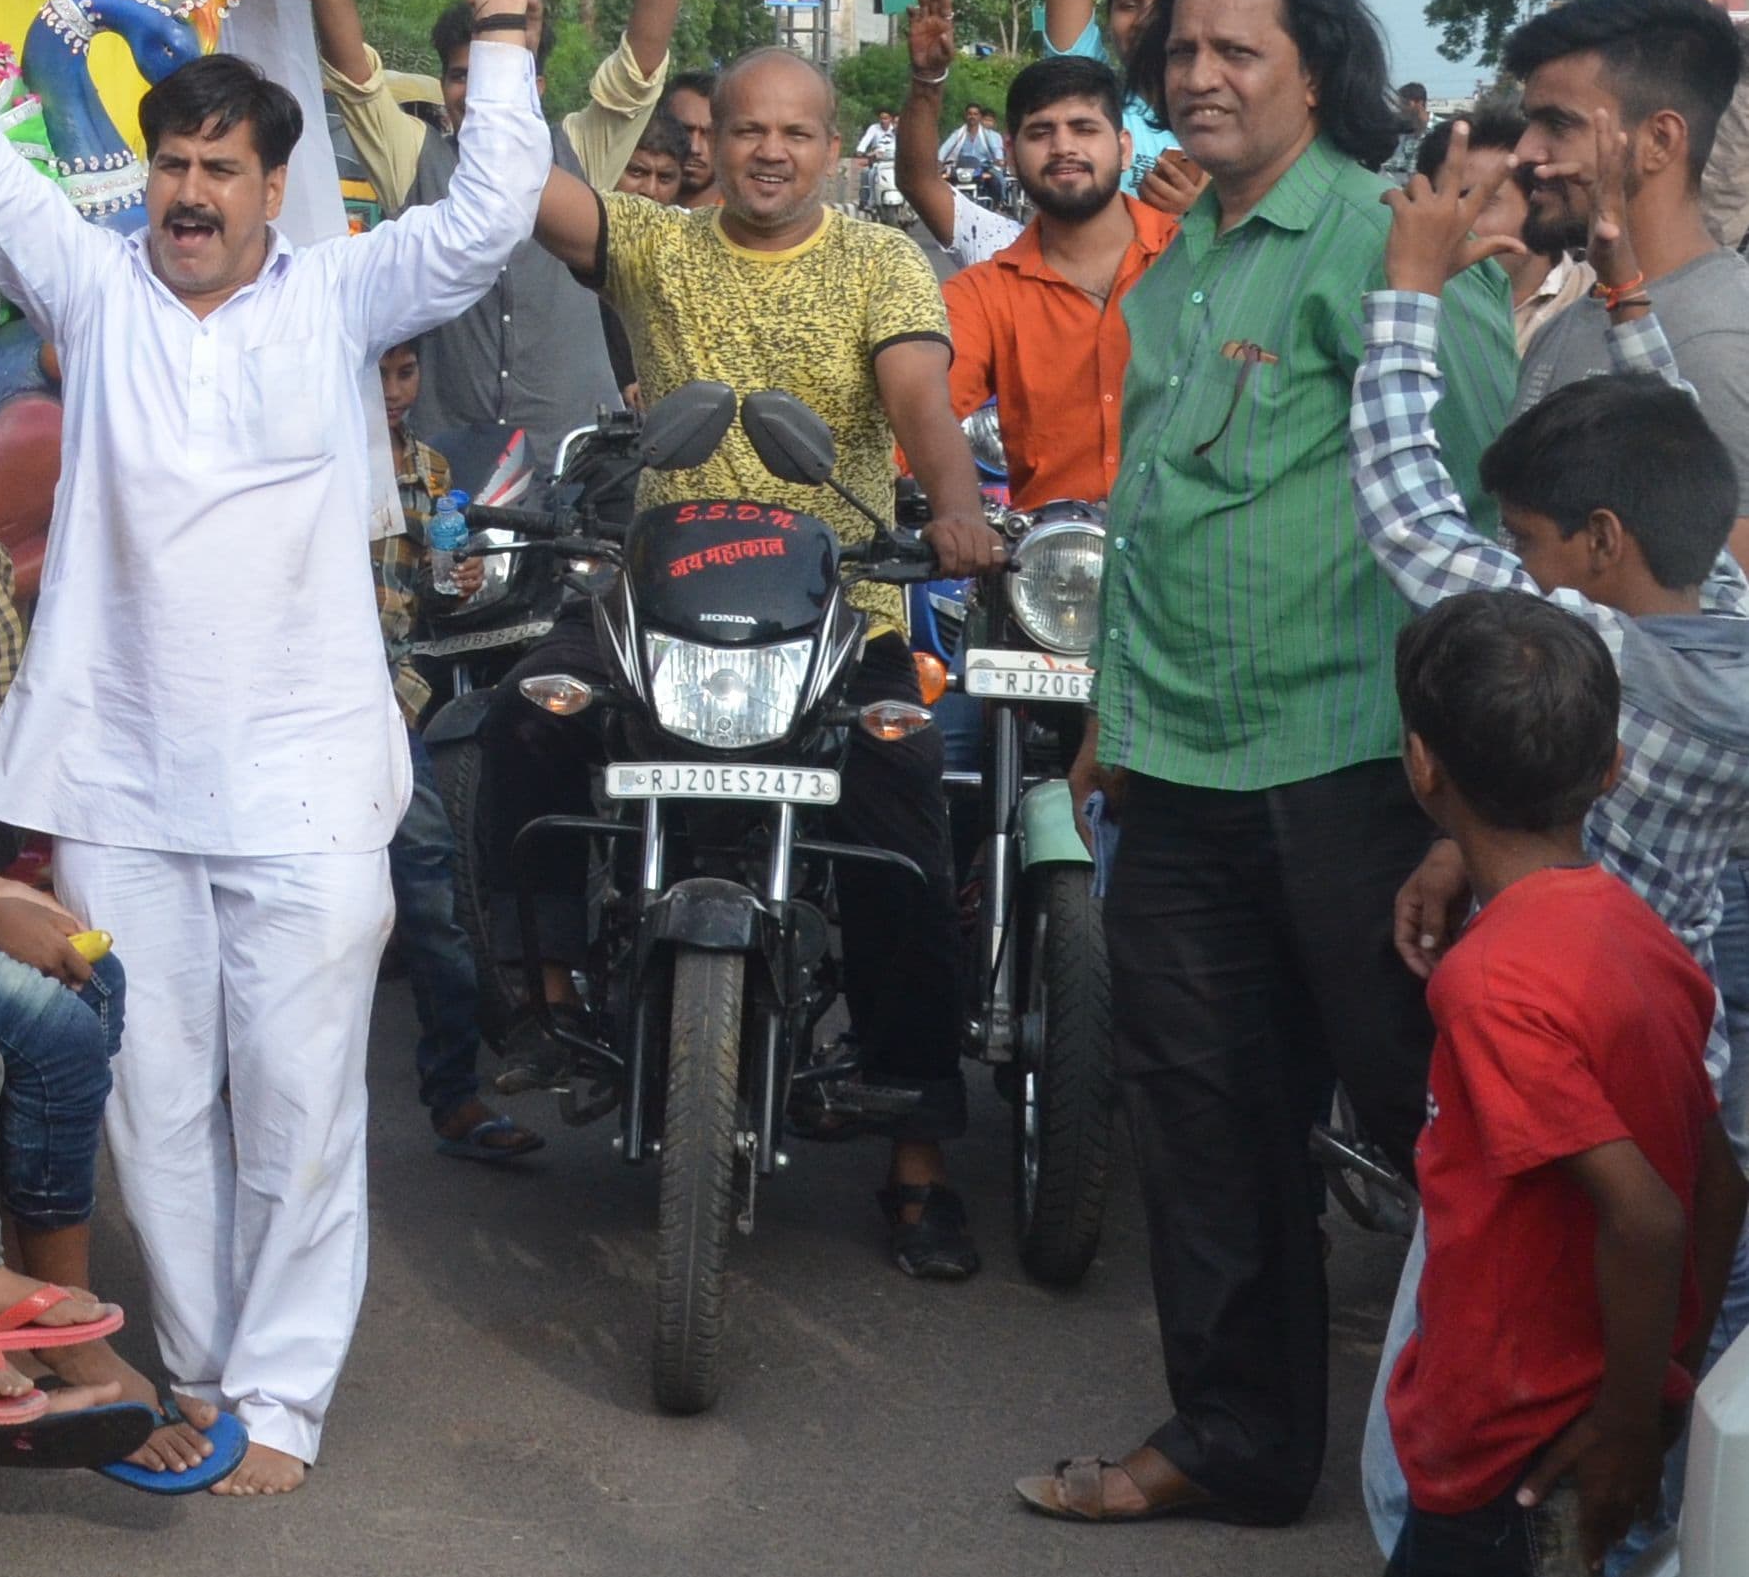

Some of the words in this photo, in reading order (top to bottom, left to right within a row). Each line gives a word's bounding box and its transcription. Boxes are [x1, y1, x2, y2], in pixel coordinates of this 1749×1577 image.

[669, 553, 704, 578] जय
[704, 537, 787, 565] महाकाल
[699, 612, 758, 625] HONDA
[651, 768, 822, 797] RJ20ES2473
